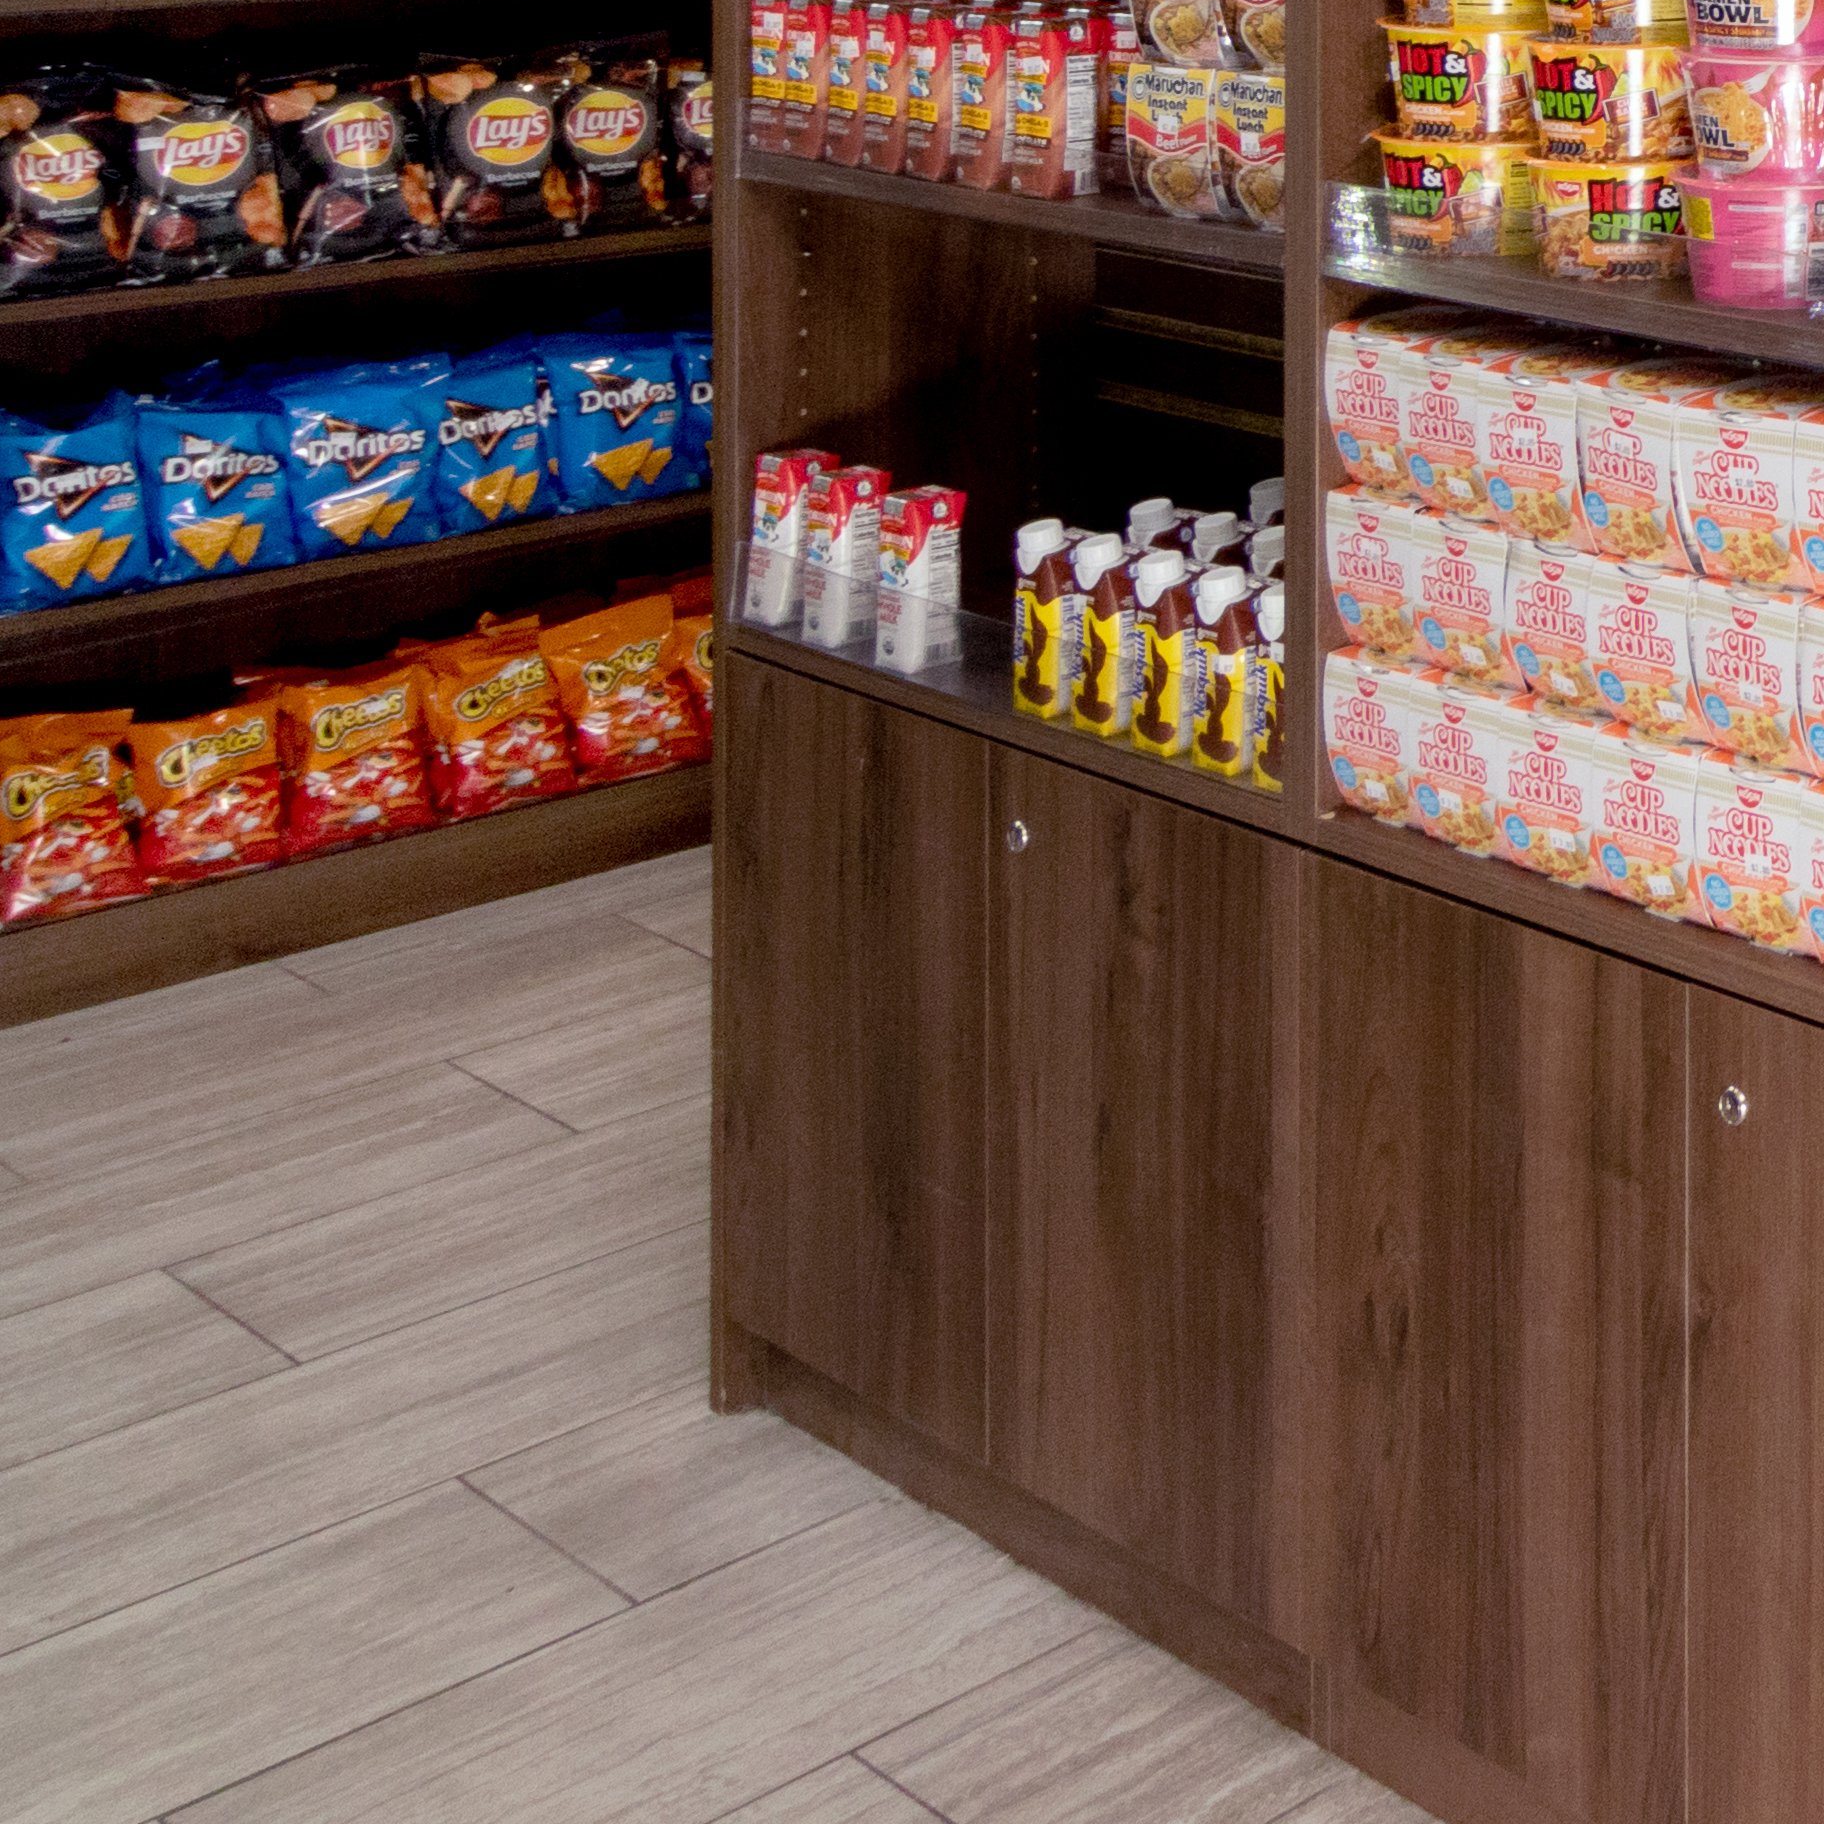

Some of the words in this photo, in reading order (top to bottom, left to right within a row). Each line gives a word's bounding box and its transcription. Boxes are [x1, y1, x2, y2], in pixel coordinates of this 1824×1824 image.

[1696, 4, 1769, 24] BOWL
[1399, 40, 1444, 75] HOT
[1445, 53, 1465, 75] &
[1402, 76, 1467, 104] SPICY
[475, 110, 548, 147] Lay's
[159, 131, 247, 168] Lay's
[308, 428, 424, 465] Doritos
[164, 451, 278, 483] Doritos
[1531, 585, 1573, 615] CUP
[1516, 602, 1586, 643] NOODLES
[1133, 629, 1145, 699] Nesquik
[1194, 647, 1208, 718] Nesquik
[1524, 750, 1564, 780] CUP
[1508, 779, 1582, 813] NOODLES
